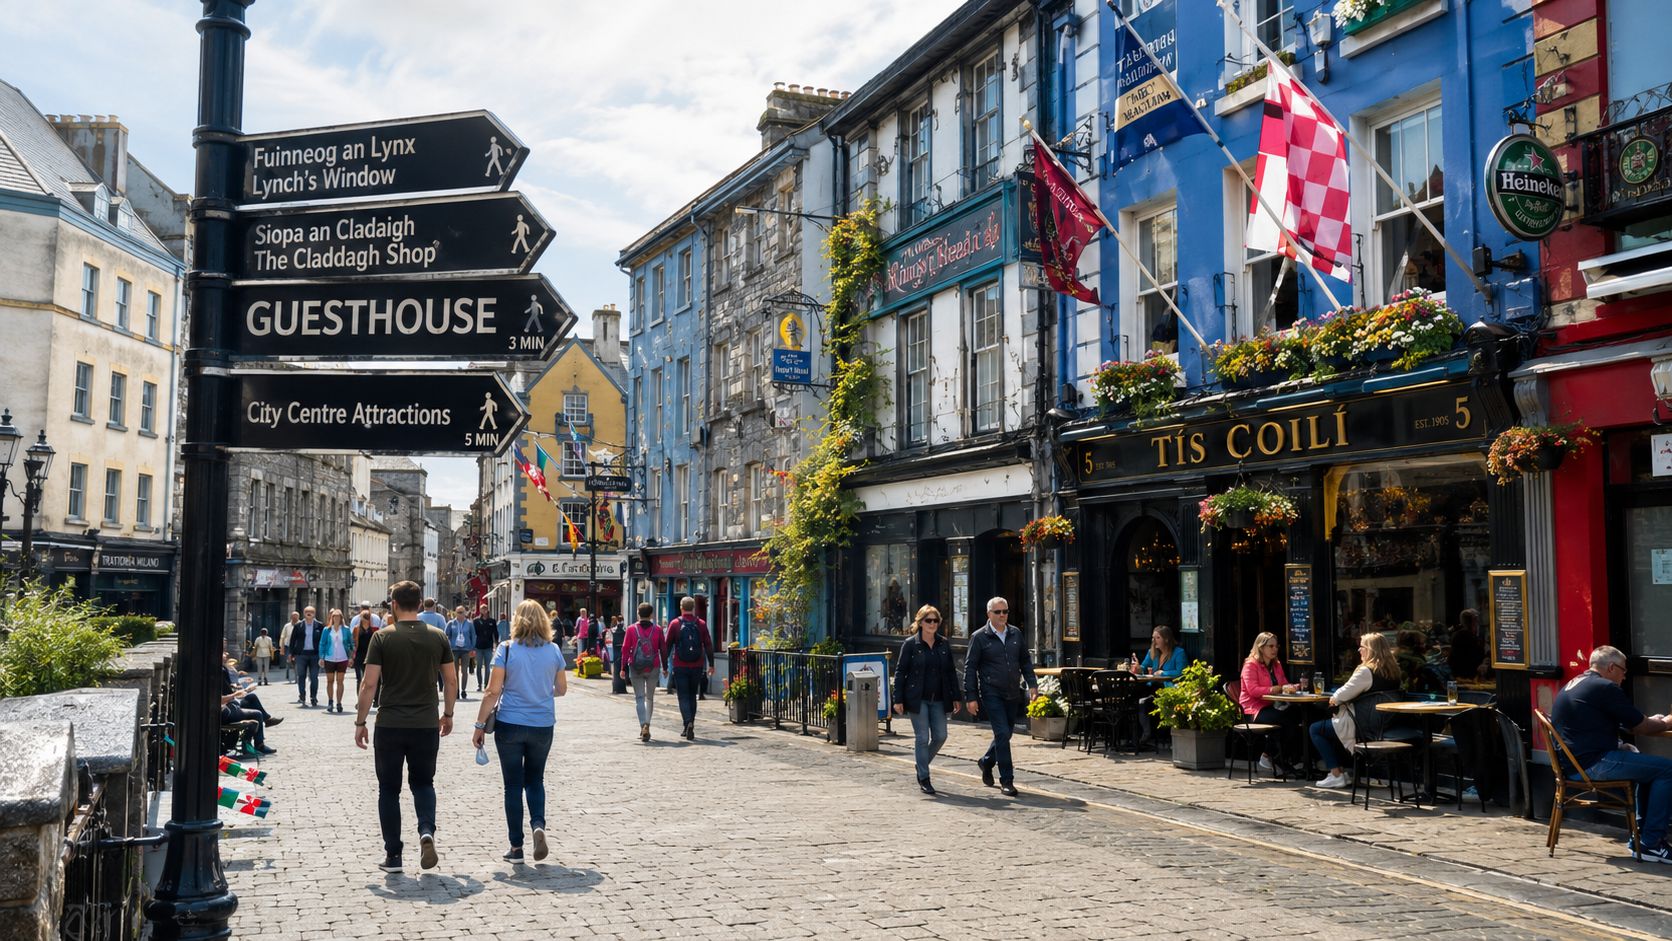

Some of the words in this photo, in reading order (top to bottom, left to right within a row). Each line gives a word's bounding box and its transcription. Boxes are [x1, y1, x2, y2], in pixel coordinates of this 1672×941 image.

[253, 147, 337, 167] Fuinneog
[342, 142, 365, 161] an
[371, 135, 416, 162] Lynx
[252, 170, 317, 200] Lynch's
[322, 165, 396, 189] Window
[1501, 172, 1563, 198] Heineke
[255, 224, 304, 249] Siopa
[309, 225, 331, 242] an
[336, 214, 415, 242] Cladaigh
[254, 250, 288, 271] The
[293, 244, 380, 272] Claddagh
[386, 243, 436, 268] Shop
[246, 297, 497, 336] GUESTHOUSE
[508, 336, 517, 350] 3
[520, 336, 545, 350] MIN
[247, 401, 282, 429] City
[287, 401, 347, 425] Centre
[352, 402, 451, 426] Attractions
[464, 433, 473, 447] 5
[475, 433, 499, 447] MIN
[1085, 451, 1093, 475] 5
[1151, 430, 1207, 468] TÍS
[1226, 404, 1349, 459] COILÍ
[1456, 396, 1471, 430] 5
